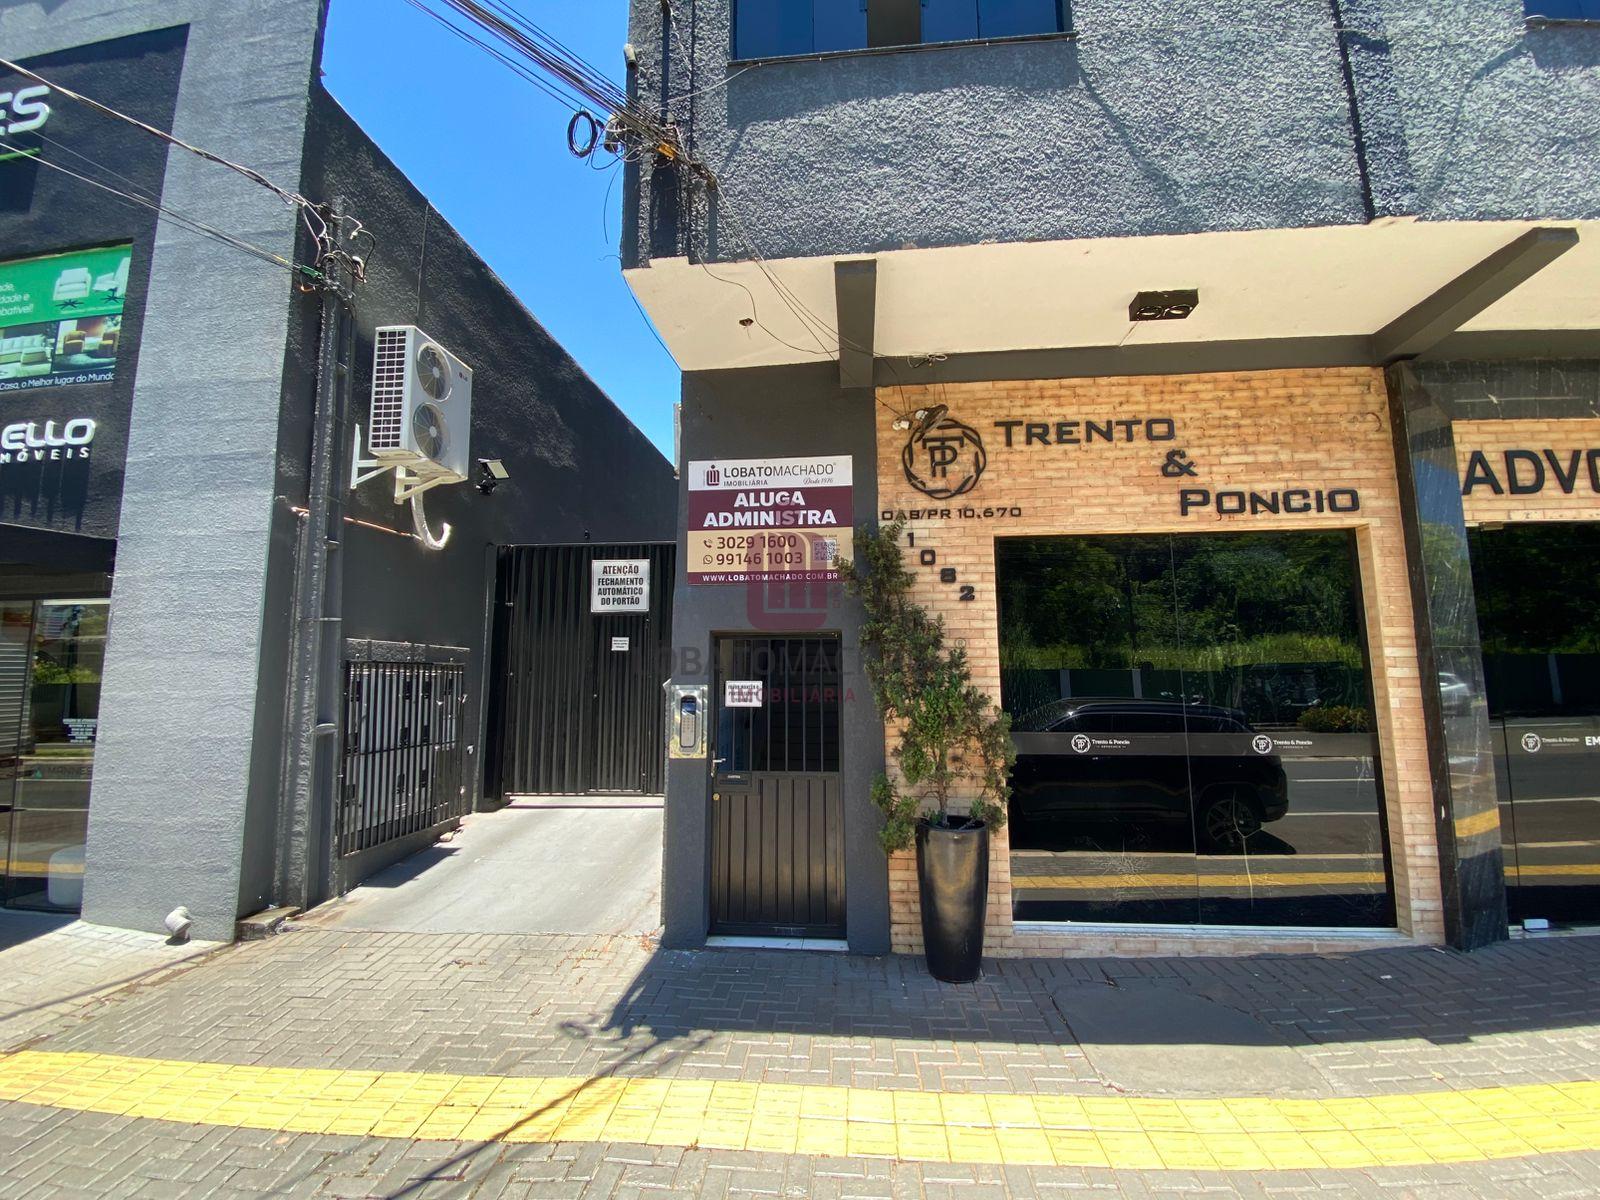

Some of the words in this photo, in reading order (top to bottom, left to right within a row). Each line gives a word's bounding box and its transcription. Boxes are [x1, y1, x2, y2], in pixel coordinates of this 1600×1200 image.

[28, 377, 53, 387] Melhor
[55, 374, 75, 386] lugar
[76, 373, 86, 382] do
[994, 417, 1176, 448] TRENTO
[1161, 449, 1199, 477] &
[723, 463, 834, 479] LOBATOMACHADO
[734, 490, 805, 508] ALUGA
[1180, 488, 1360, 517] PONCIO
[703, 509, 837, 528] ADMINISTRA
[881, 508, 951, 521] OAB/PR
[716, 536, 755, 550] 3029
[760, 535, 797, 549] 1600
[716, 552, 762, 566] 99146
[766, 552, 803, 565] 1003
[602, 563, 639, 576] ATENÇÃO
[597, 577, 644, 586] FECHAMENTO
[597, 586, 643, 596] AUTOMÁTICO
[600, 597, 611, 606] DO
[612, 595, 640, 606] PORTÃO
